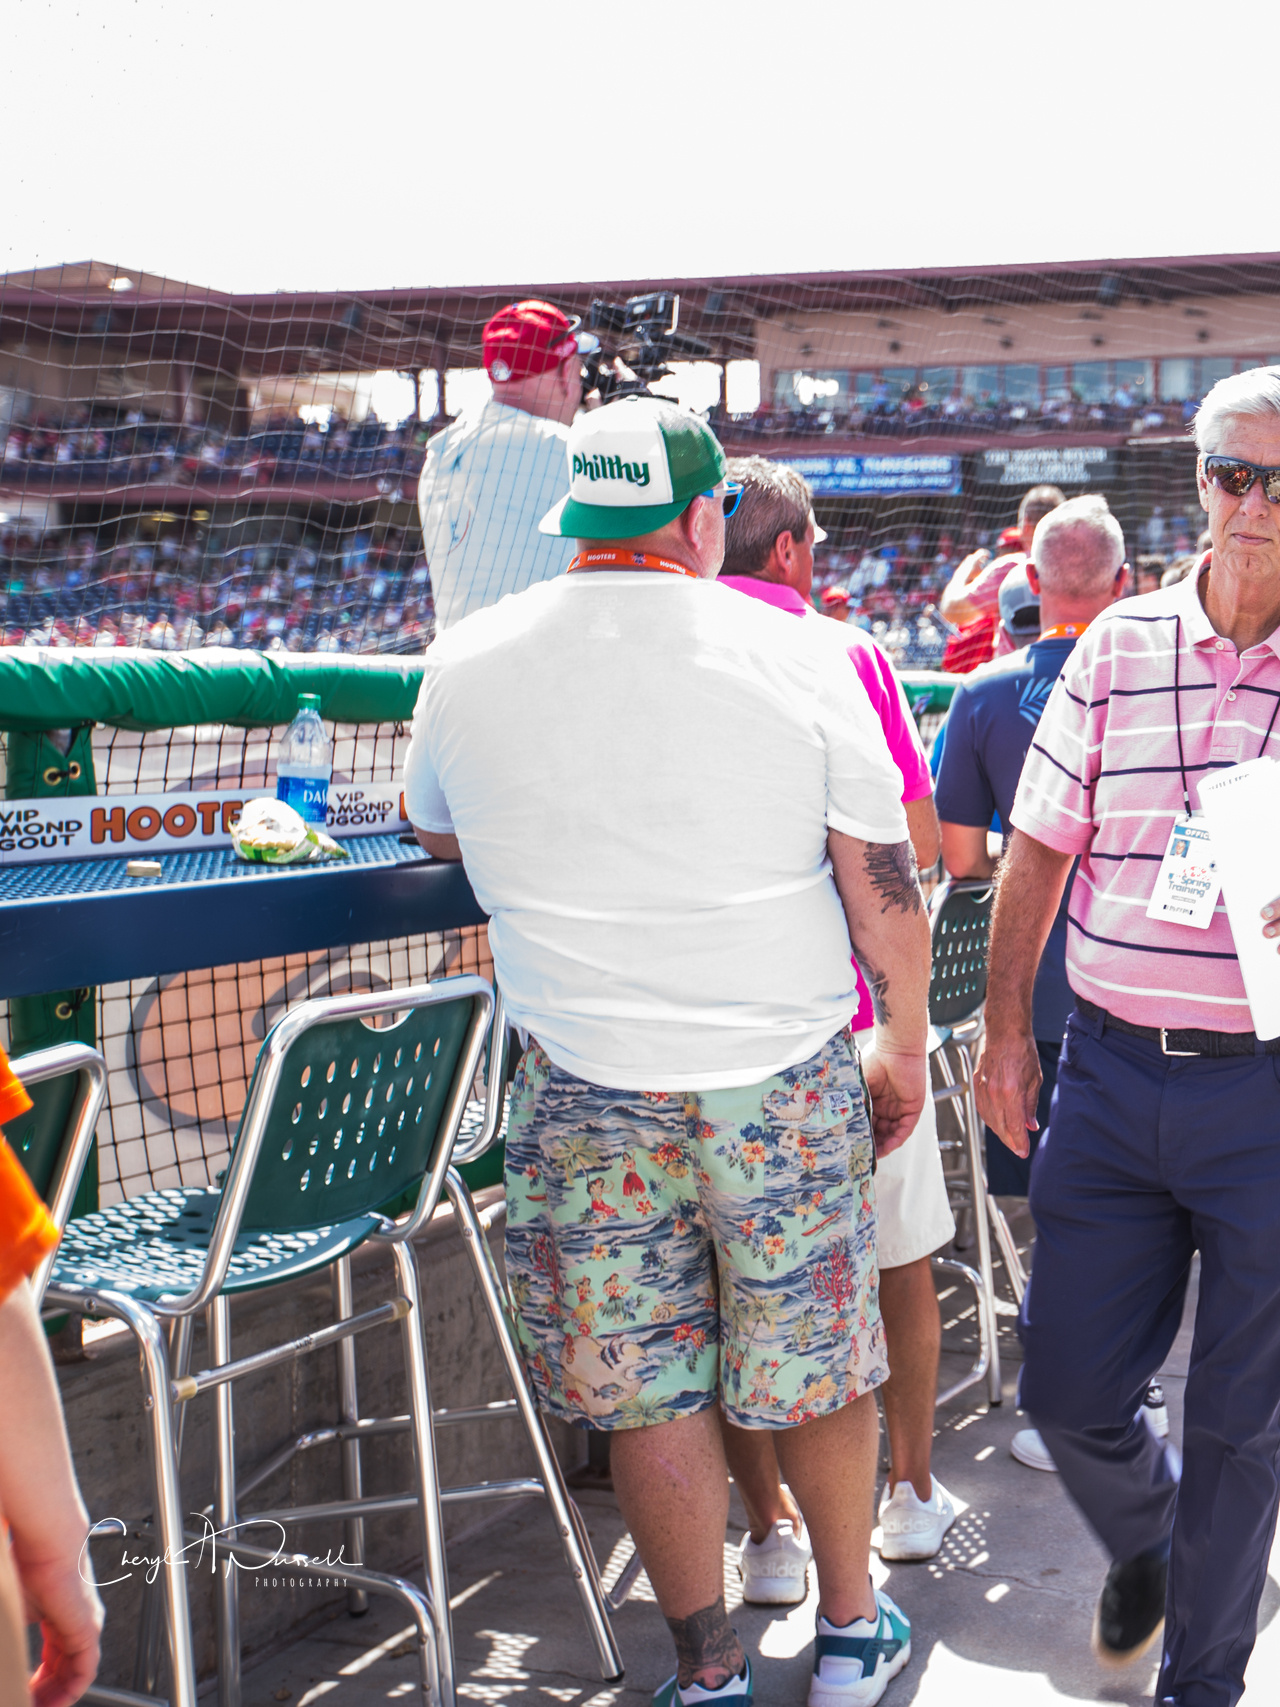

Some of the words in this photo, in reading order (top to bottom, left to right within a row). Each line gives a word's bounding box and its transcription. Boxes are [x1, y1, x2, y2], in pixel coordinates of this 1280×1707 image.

[572, 452, 650, 487] philthy
[586, 553, 616, 561] HOOTERS
[659, 560, 686, 575] HOOTERS
[336, 792, 365, 804] VIP
[1168, 880, 1206, 898] Training
[1181, 875, 1211, 891] Spring
